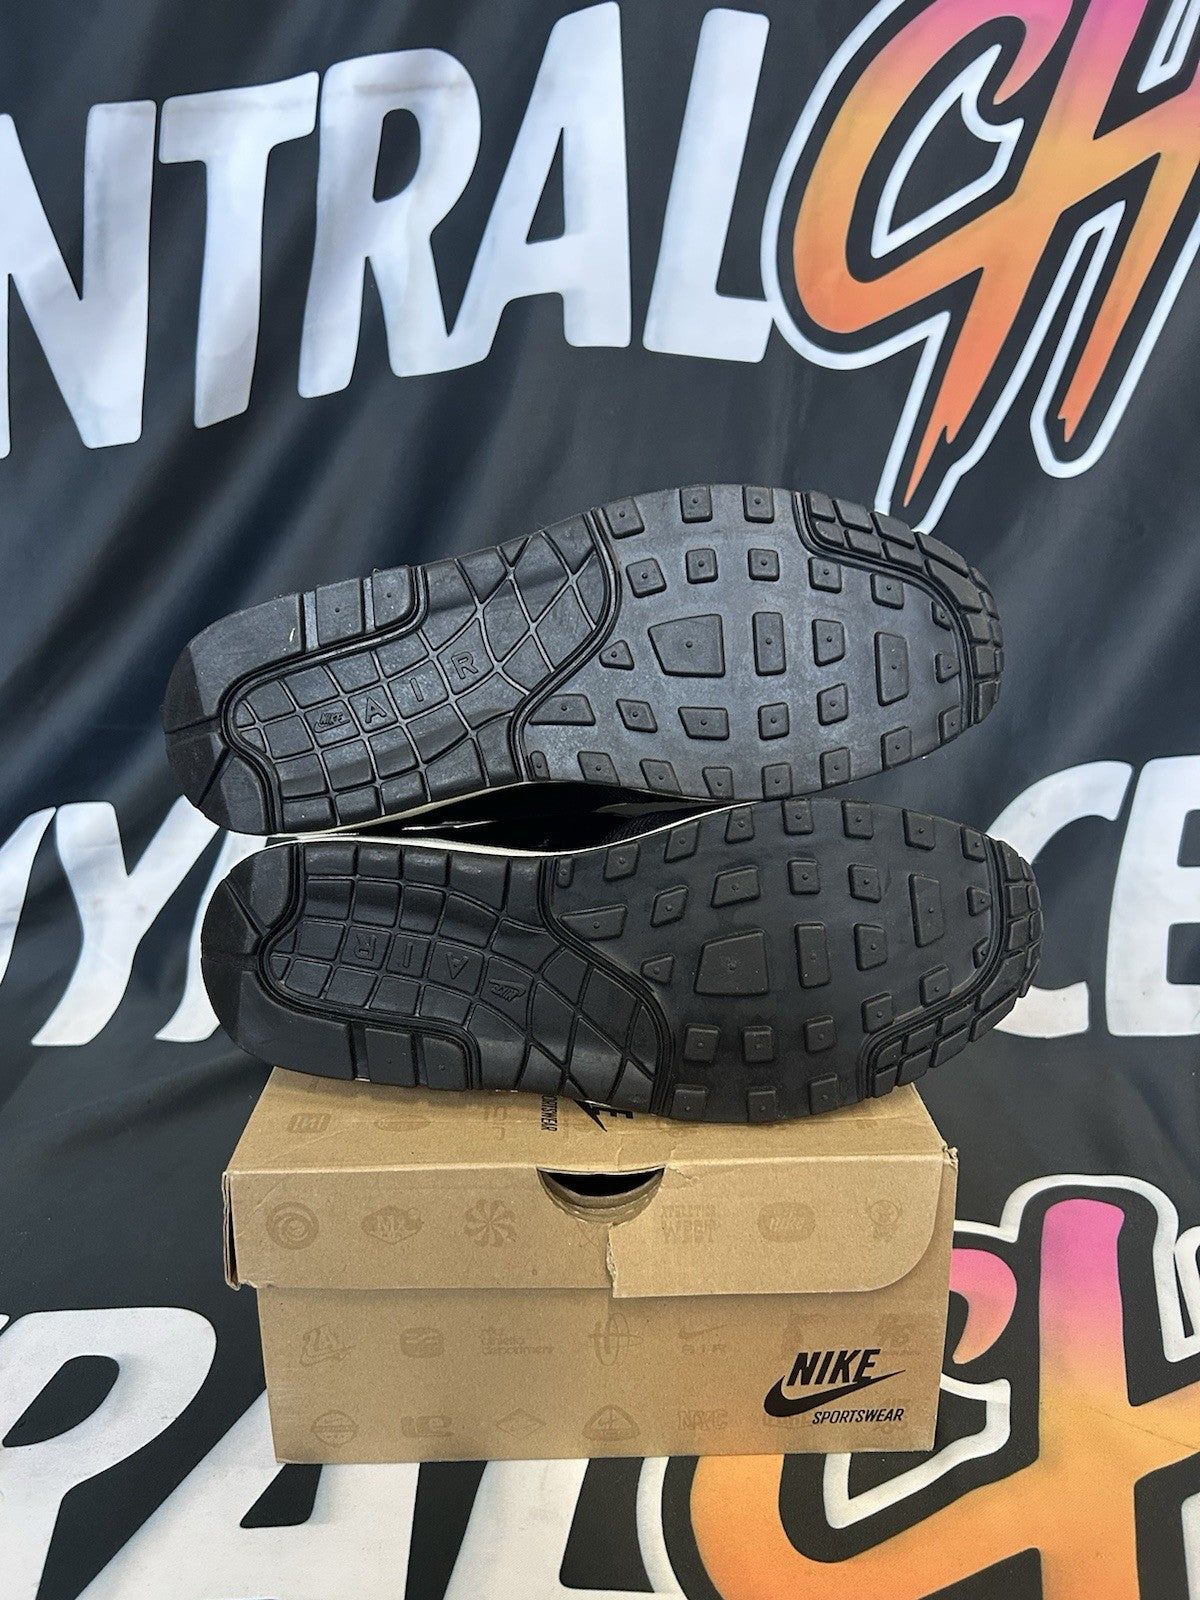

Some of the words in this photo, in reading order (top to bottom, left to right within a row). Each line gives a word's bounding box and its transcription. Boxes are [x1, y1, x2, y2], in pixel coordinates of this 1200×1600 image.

[364, 651, 478, 723] AIR
[541, 1093, 558, 1131] ORTSWEAR
[786, 1349, 881, 1387] NIKE
[811, 1407, 905, 1425] SPORTSWEAR
